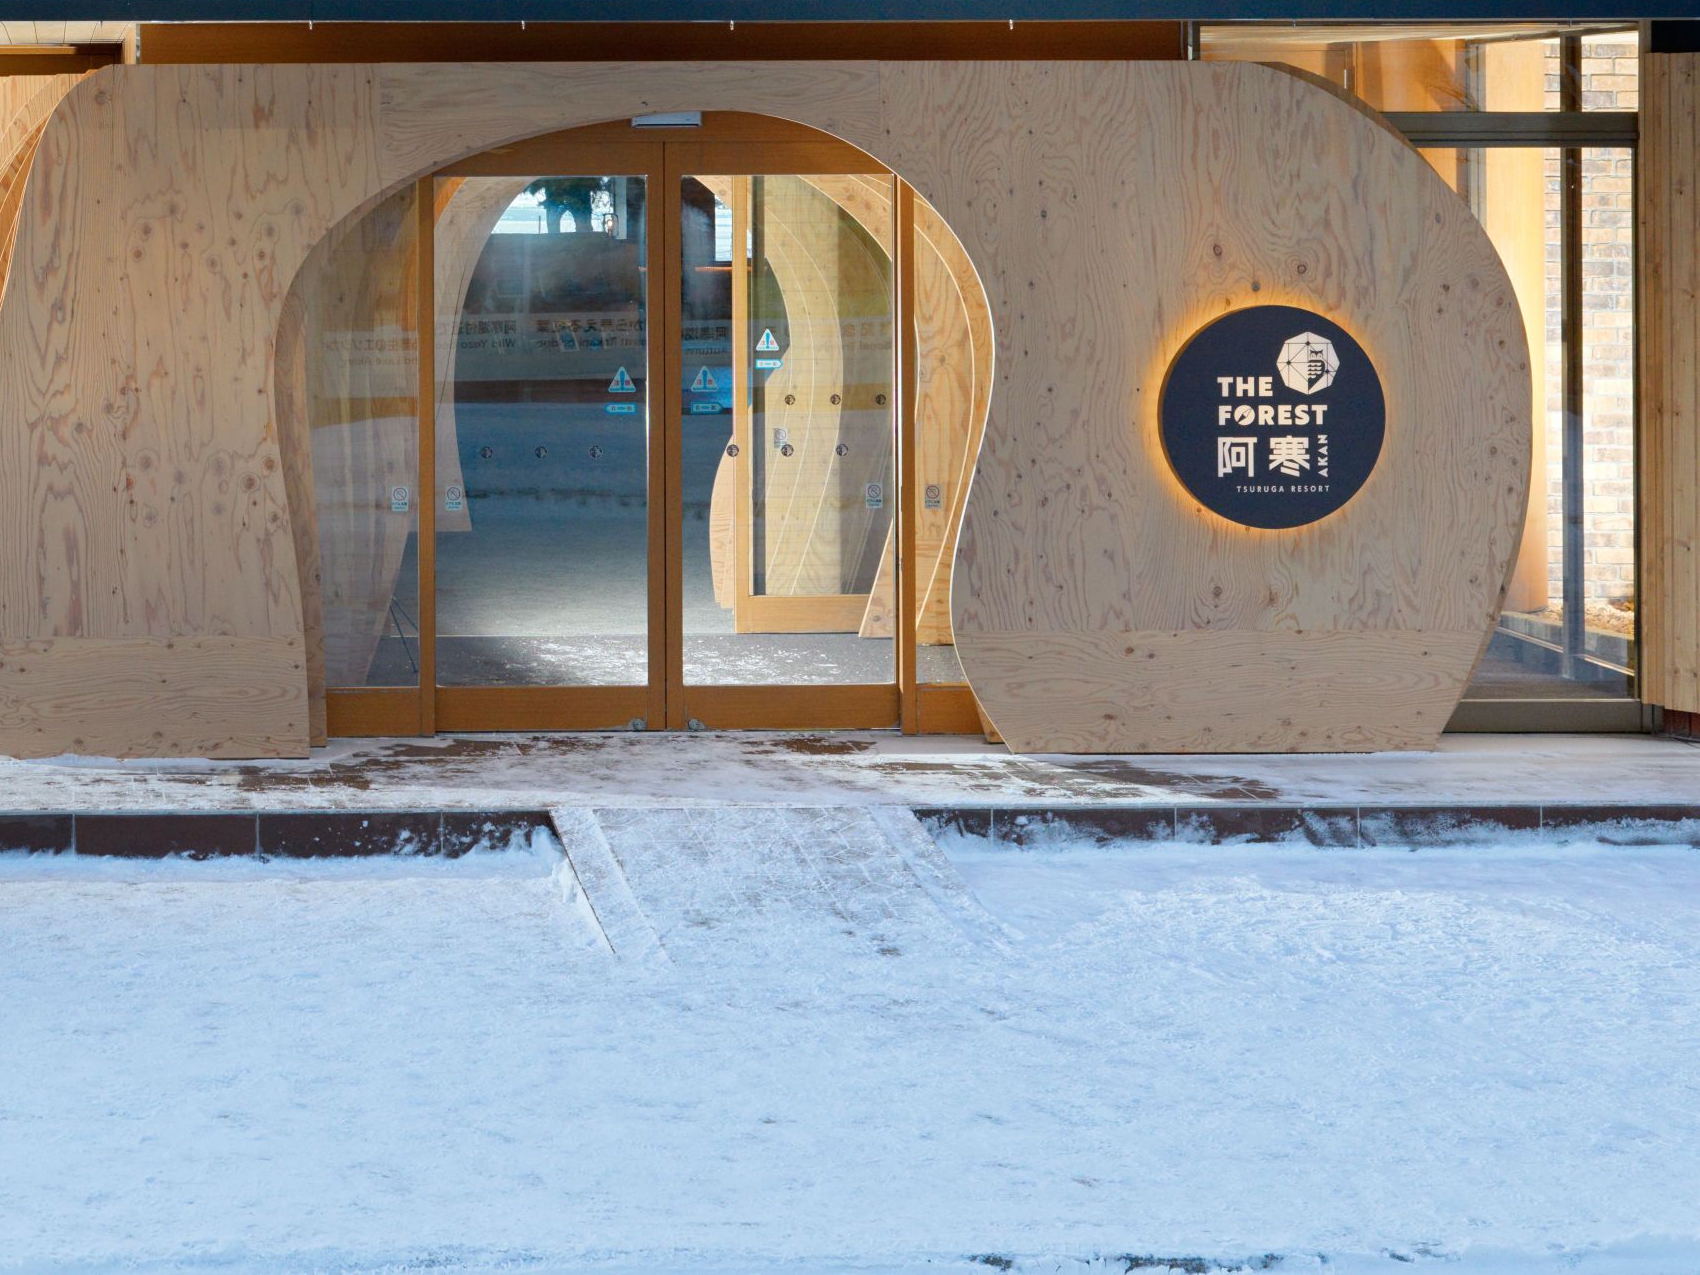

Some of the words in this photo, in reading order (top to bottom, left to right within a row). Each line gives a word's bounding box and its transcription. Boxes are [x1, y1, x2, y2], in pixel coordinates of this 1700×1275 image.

[1217, 376, 1273, 397] THE
[1218, 404, 1328, 426] FOREST
[1217, 435, 1311, 478] 阿寒
[1317, 434, 1329, 478] AKAN
[1236, 485, 1285, 493] TSURUGA
[1291, 484, 1331, 493] RESORT
